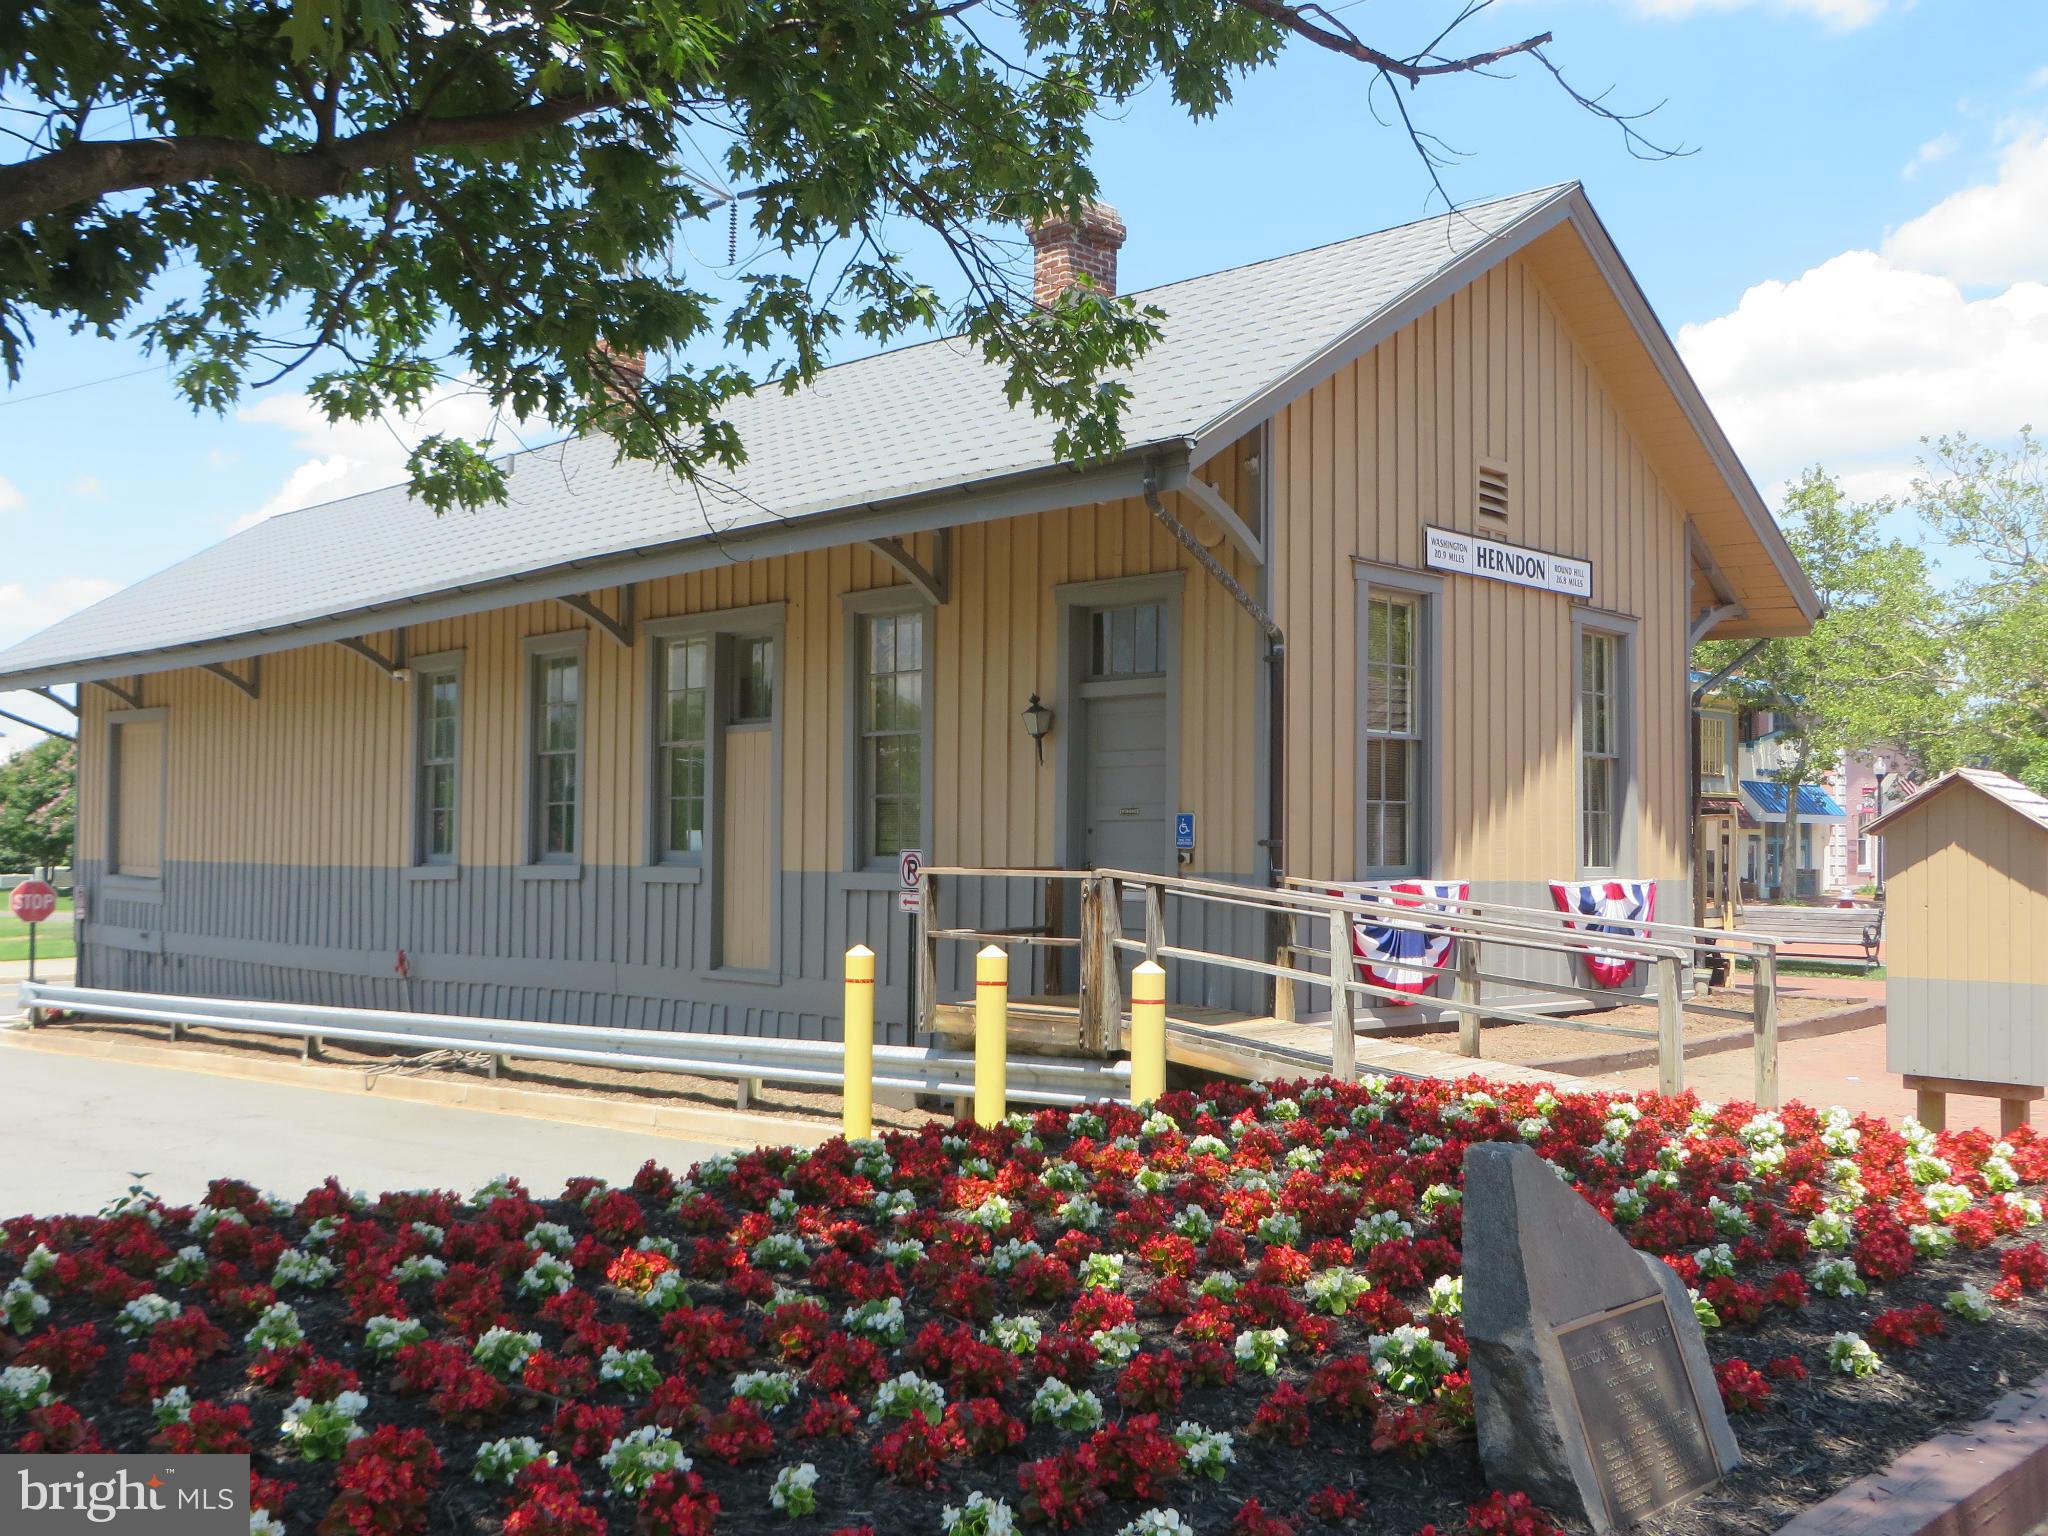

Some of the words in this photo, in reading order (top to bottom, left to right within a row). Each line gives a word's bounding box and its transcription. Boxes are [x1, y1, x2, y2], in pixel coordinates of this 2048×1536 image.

[1430, 537, 1468, 553] WASHINGTON
[1448, 552, 1465, 564] MILES
[1477, 546, 1546, 581] HERNDON
[1554, 564, 1572, 576] ROUND
[1573, 568, 1585, 578] HILL
[1568, 577, 1584, 588] MILES
[12, 893, 54, 911] STOP
